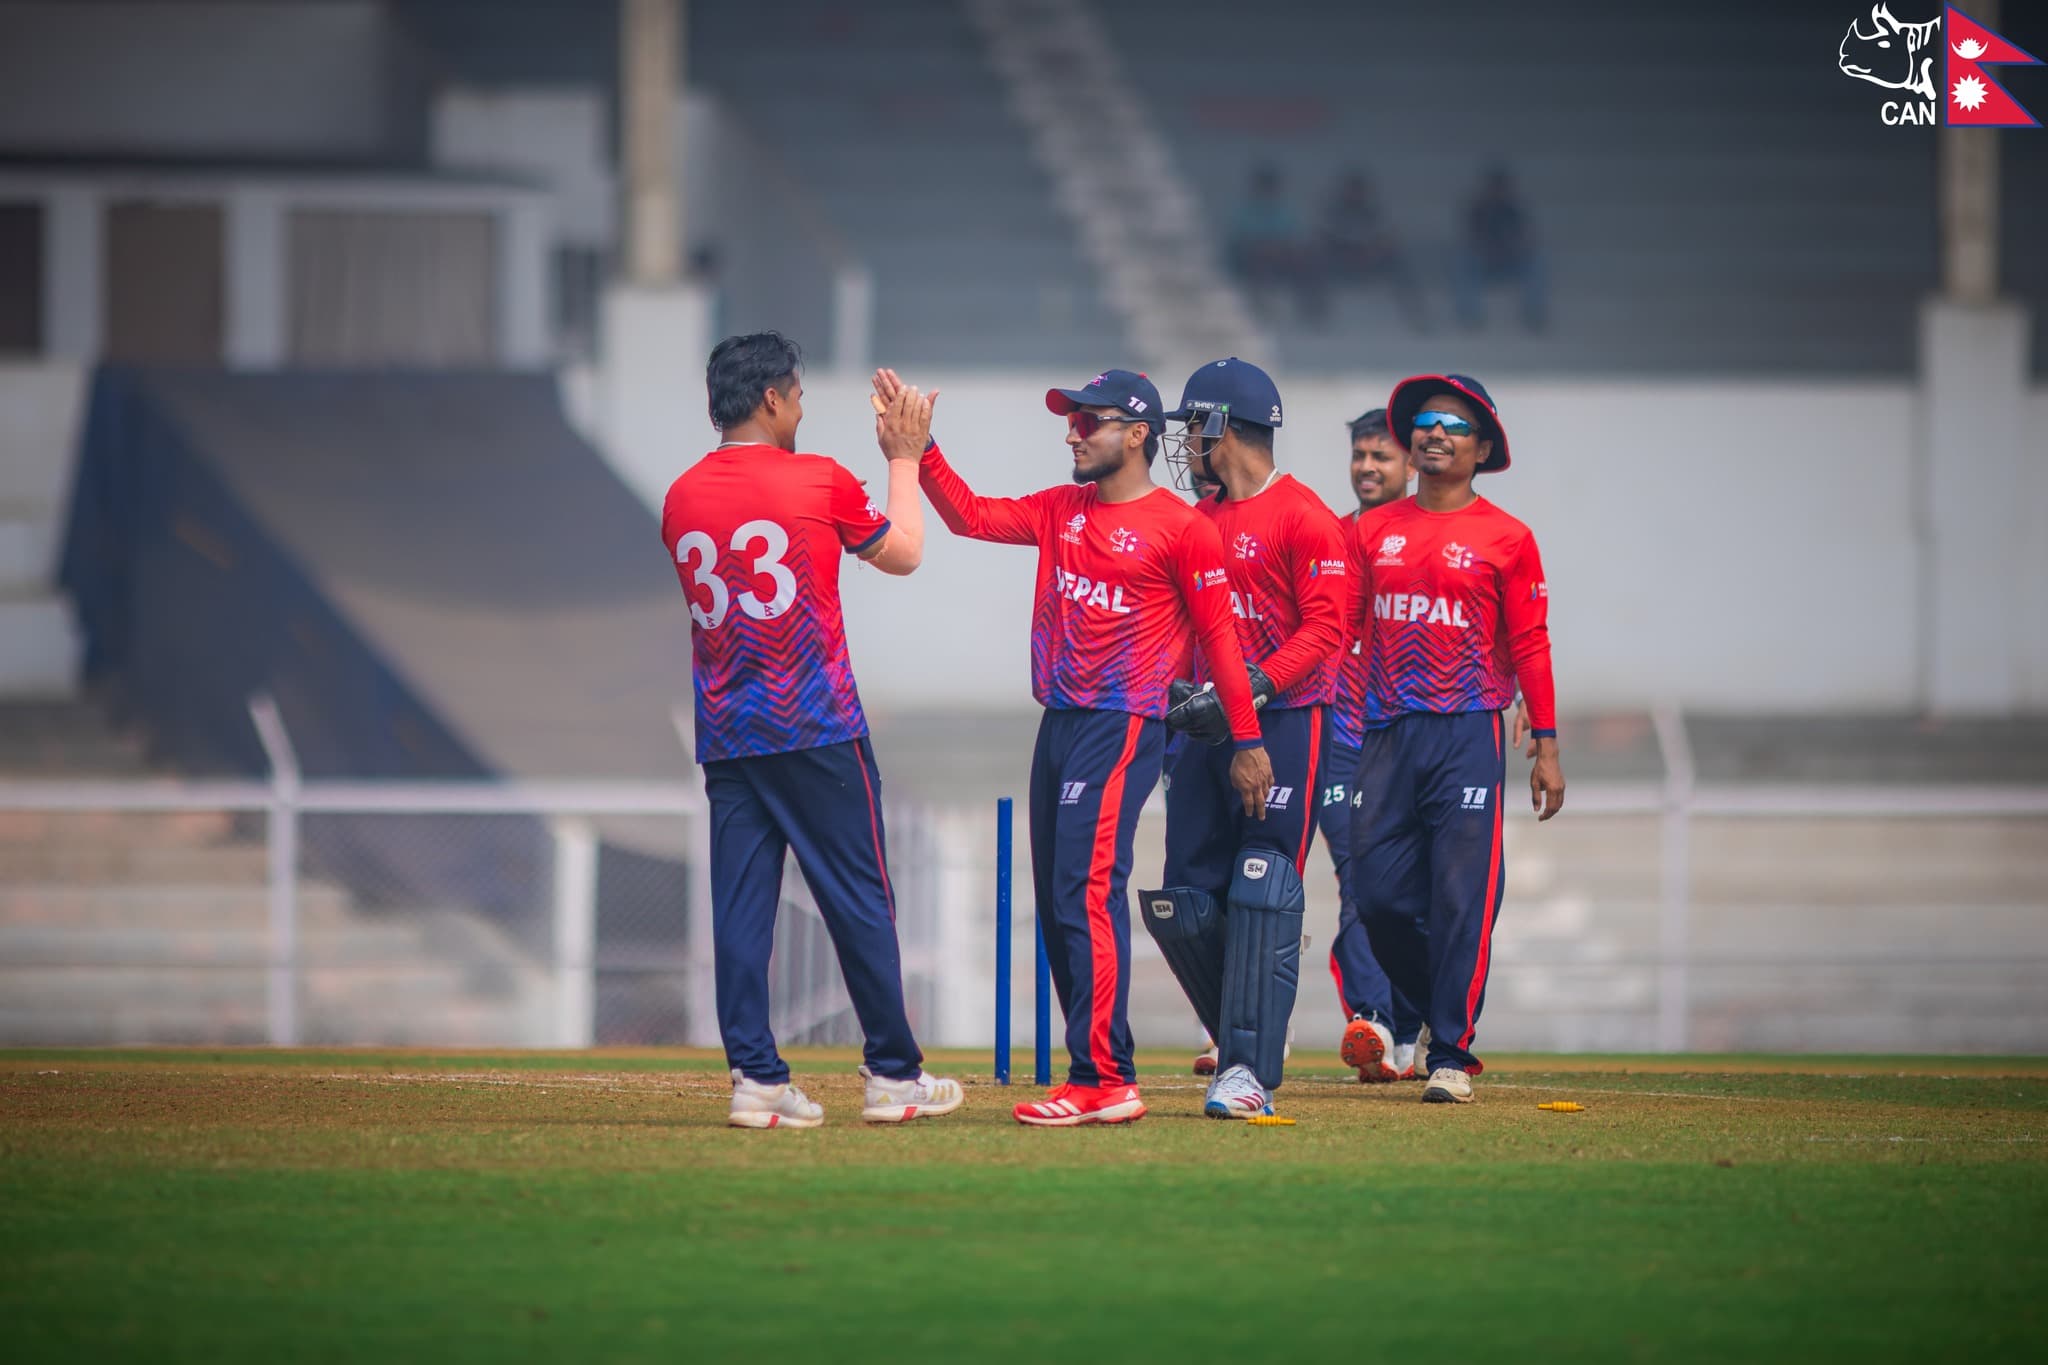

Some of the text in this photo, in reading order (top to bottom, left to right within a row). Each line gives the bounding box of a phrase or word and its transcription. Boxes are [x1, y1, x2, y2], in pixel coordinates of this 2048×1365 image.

[676, 519, 797, 630] 33
[1320, 560, 1345, 568] NAASA
[1056, 565, 1131, 613] NEPAL
[1230, 592, 1263, 621] AL
[1374, 593, 1469, 628] NEPAL
[1323, 784, 1345, 806] 25
